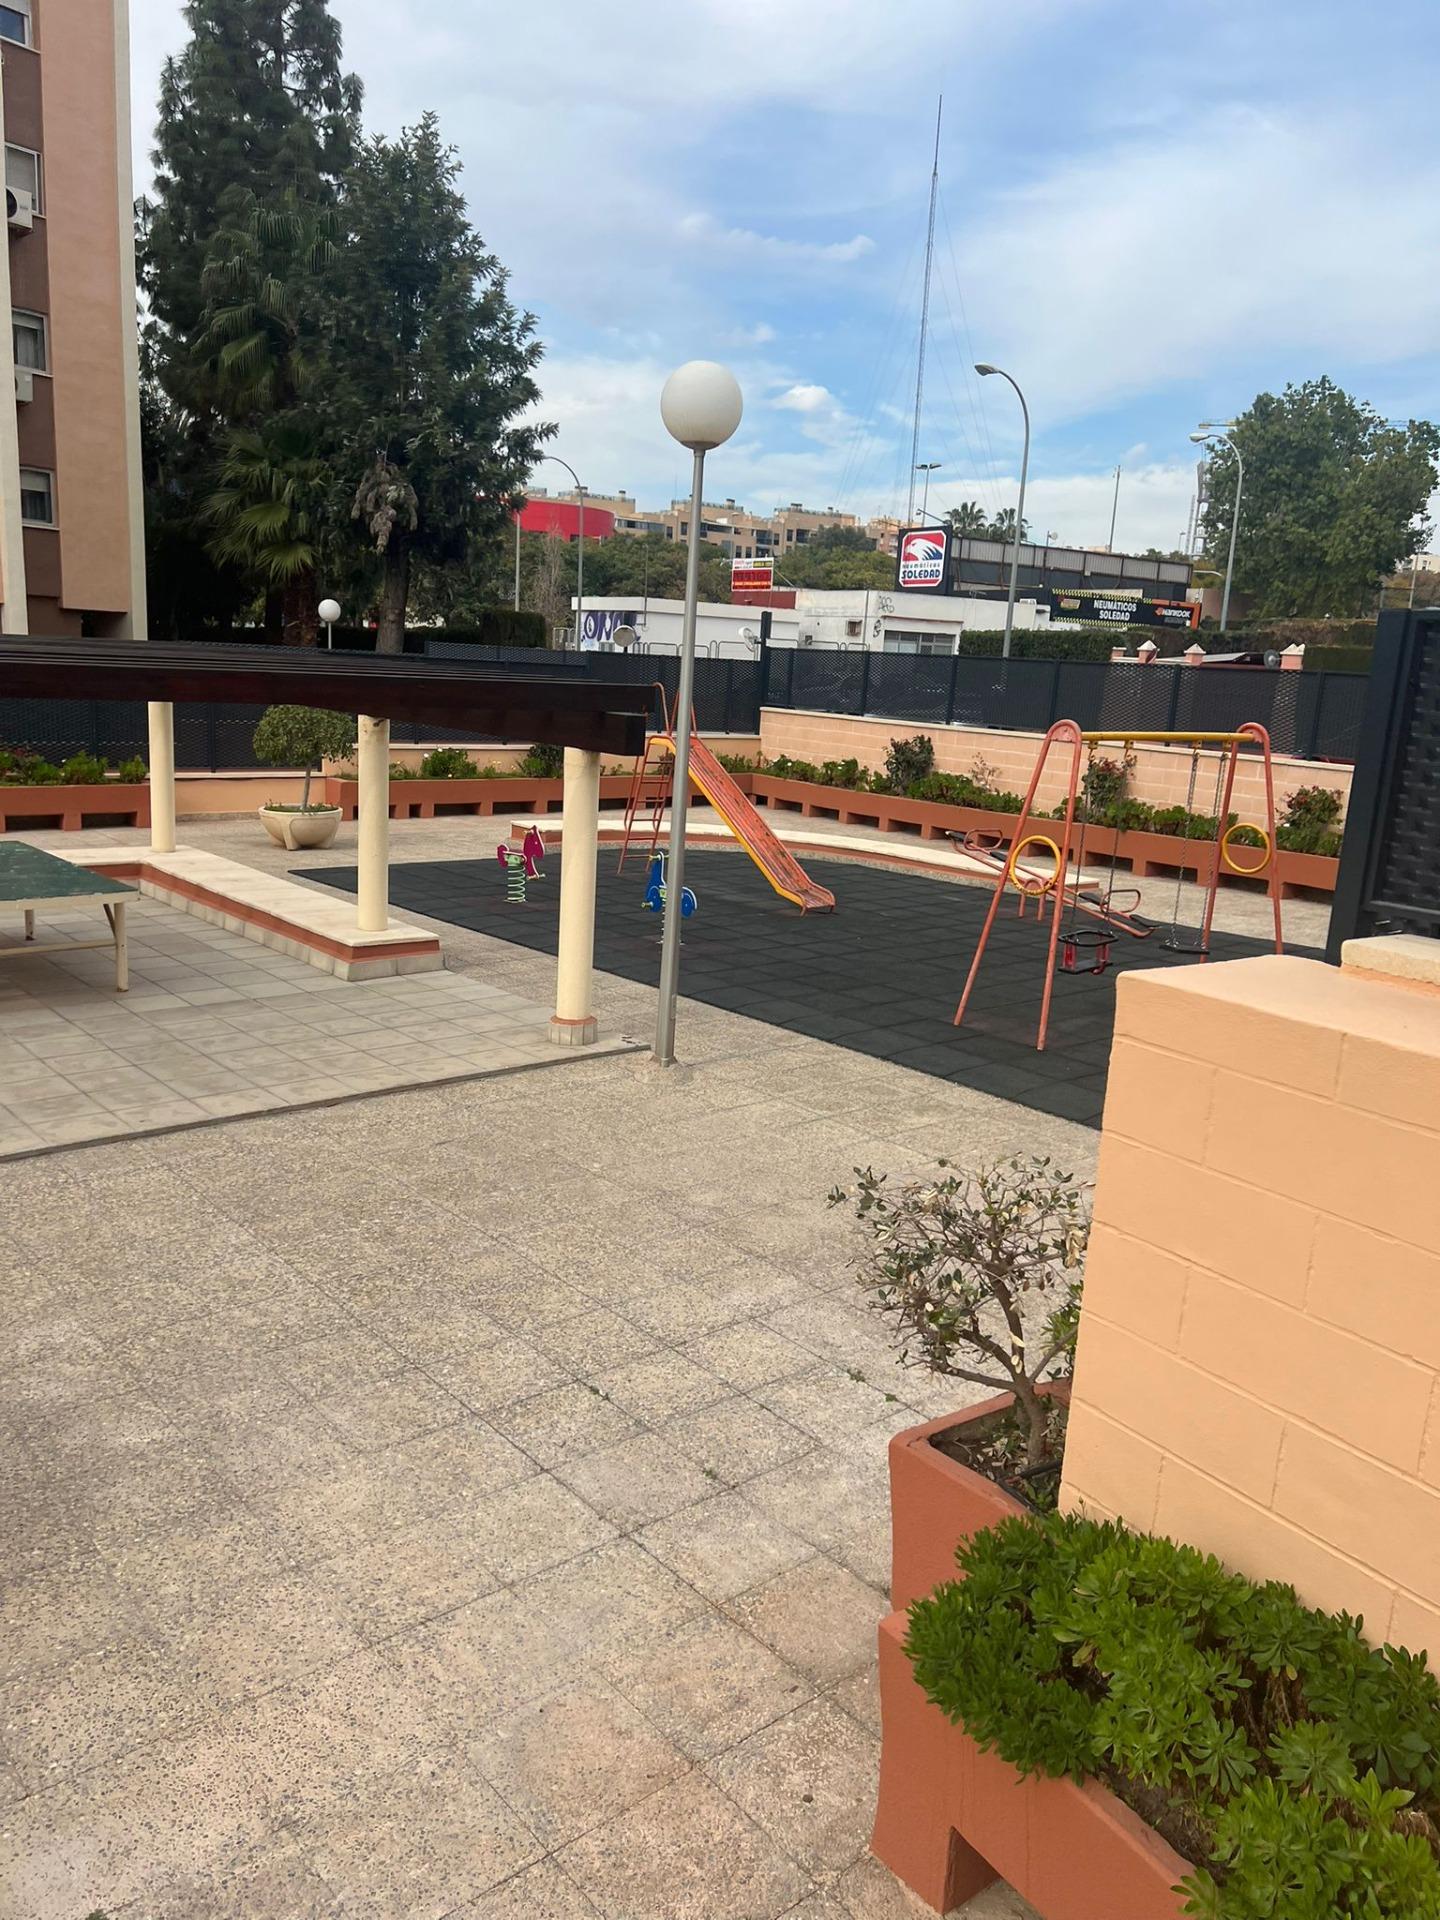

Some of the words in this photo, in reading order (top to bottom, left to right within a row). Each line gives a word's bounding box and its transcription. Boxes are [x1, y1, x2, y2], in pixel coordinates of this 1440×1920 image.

[901, 569, 940, 579] SOLEDAD
[1093, 599, 1137, 612] NEUMÁTICOS
[1099, 610, 1130, 621] SOLEDAD
